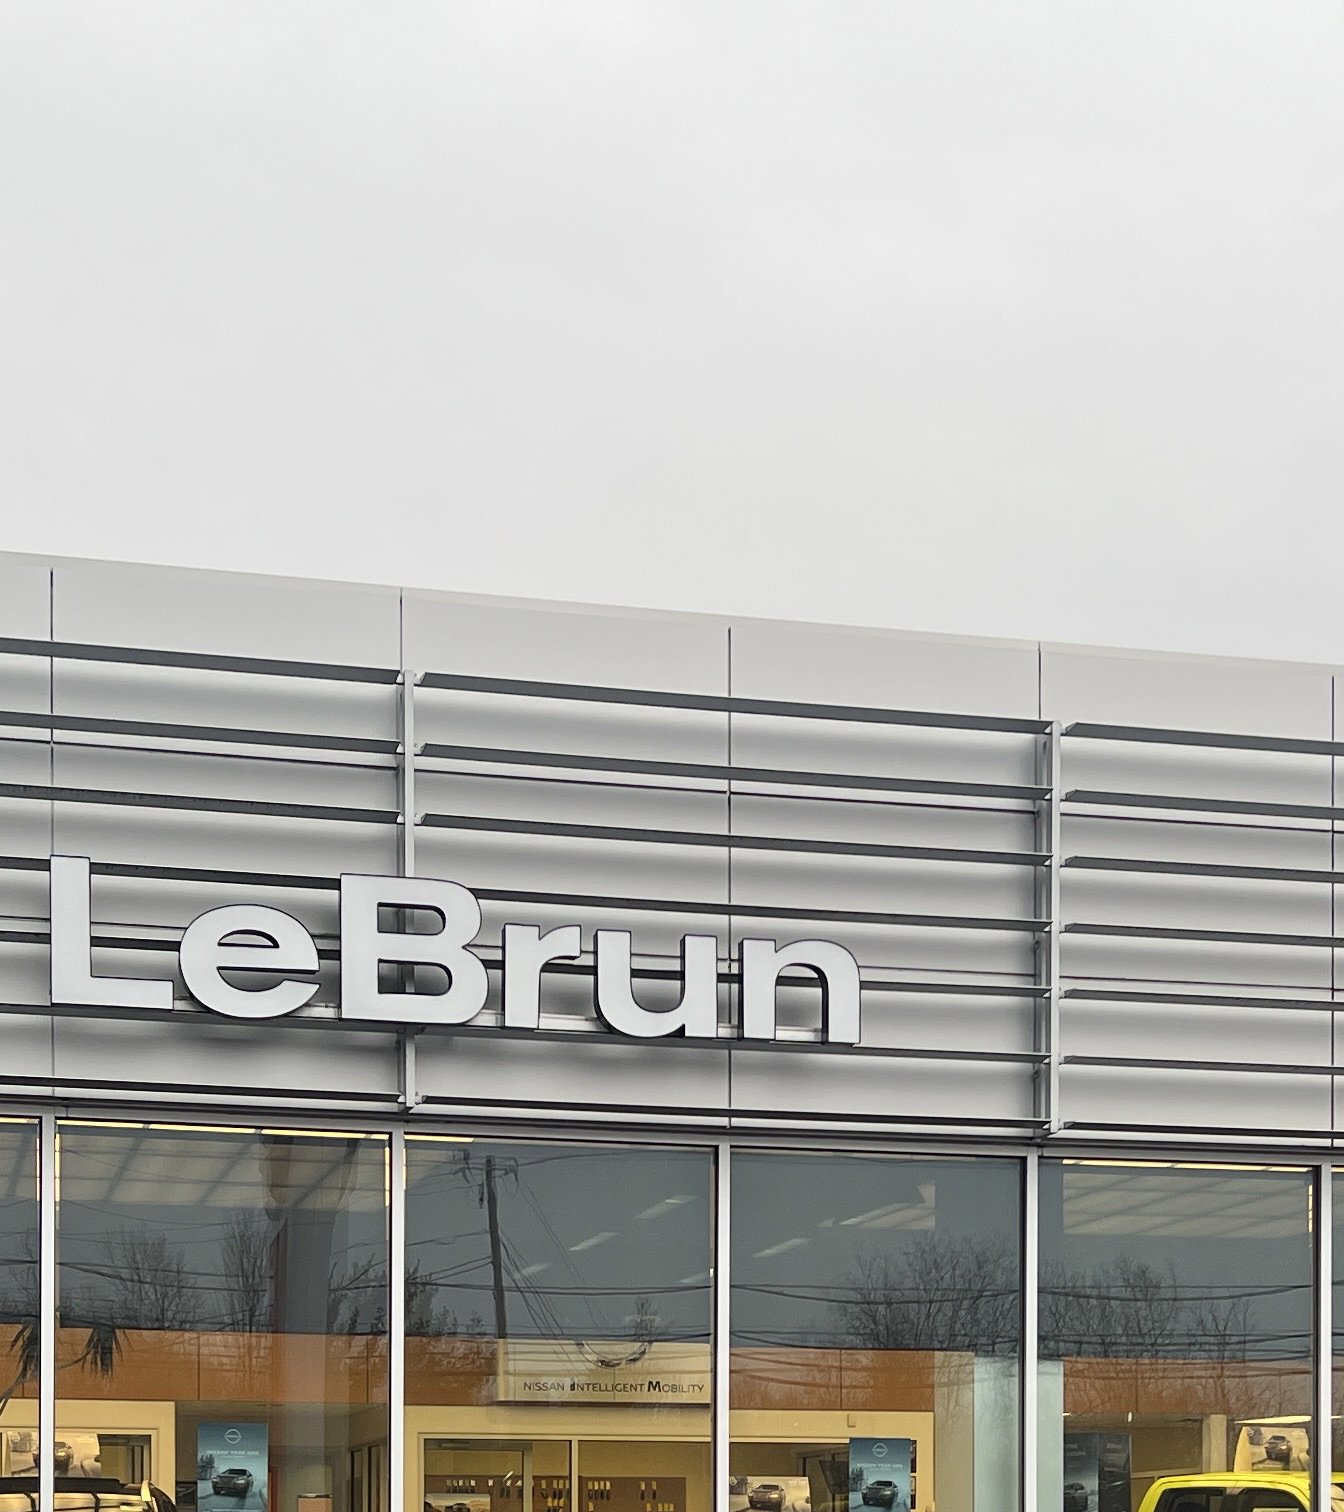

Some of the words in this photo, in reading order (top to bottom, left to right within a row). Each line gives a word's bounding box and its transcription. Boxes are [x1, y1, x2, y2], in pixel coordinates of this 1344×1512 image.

[50, 855, 862, 1046] LeBrun
[523, 1381, 565, 1392] NISSAN
[569, 1378, 645, 1393] INTELLIGENT
[647, 1380, 705, 1394] MOBILITY
